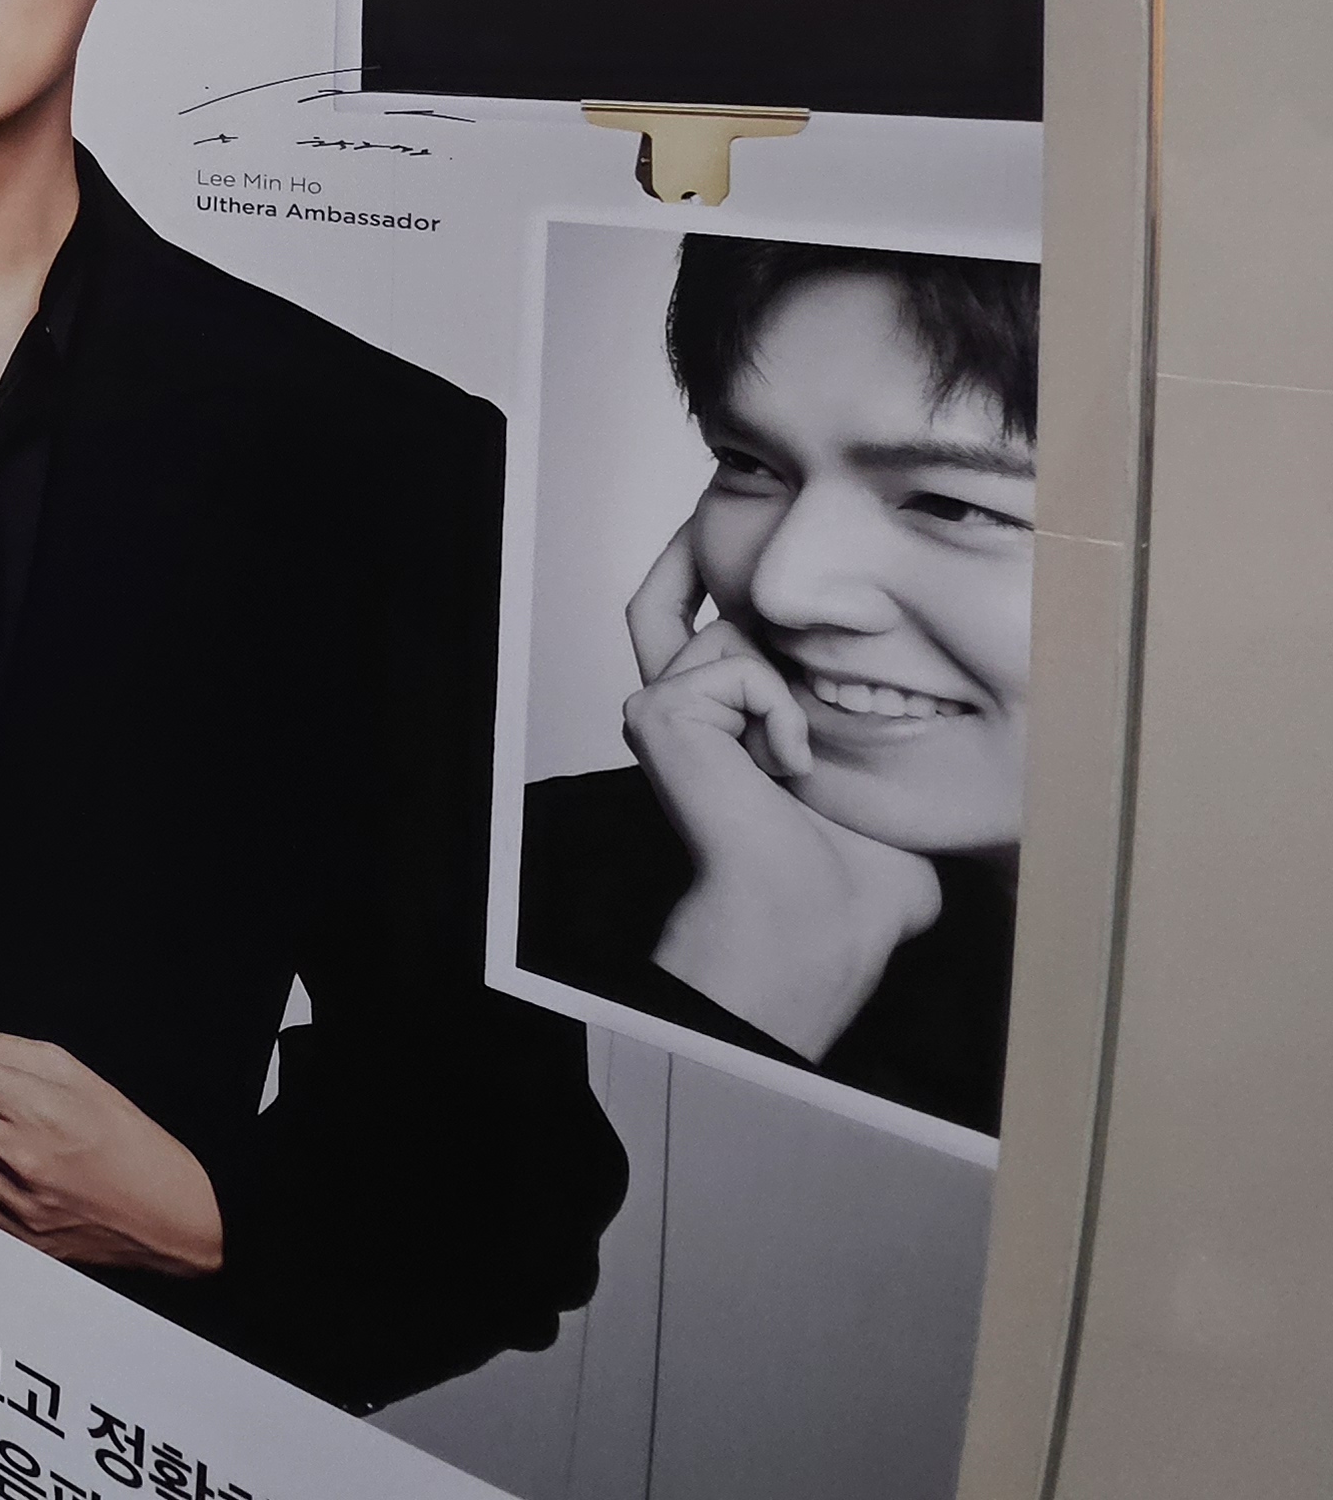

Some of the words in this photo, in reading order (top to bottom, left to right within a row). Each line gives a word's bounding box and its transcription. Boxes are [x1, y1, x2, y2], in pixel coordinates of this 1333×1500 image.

[197, 169, 236, 188] Lee
[244, 172, 282, 191] Min
[290, 176, 322, 195] Ho
[196, 195, 277, 217] Ulthera
[285, 203, 441, 232] Ambassador
[87, 1403, 270, 1500] 정확
